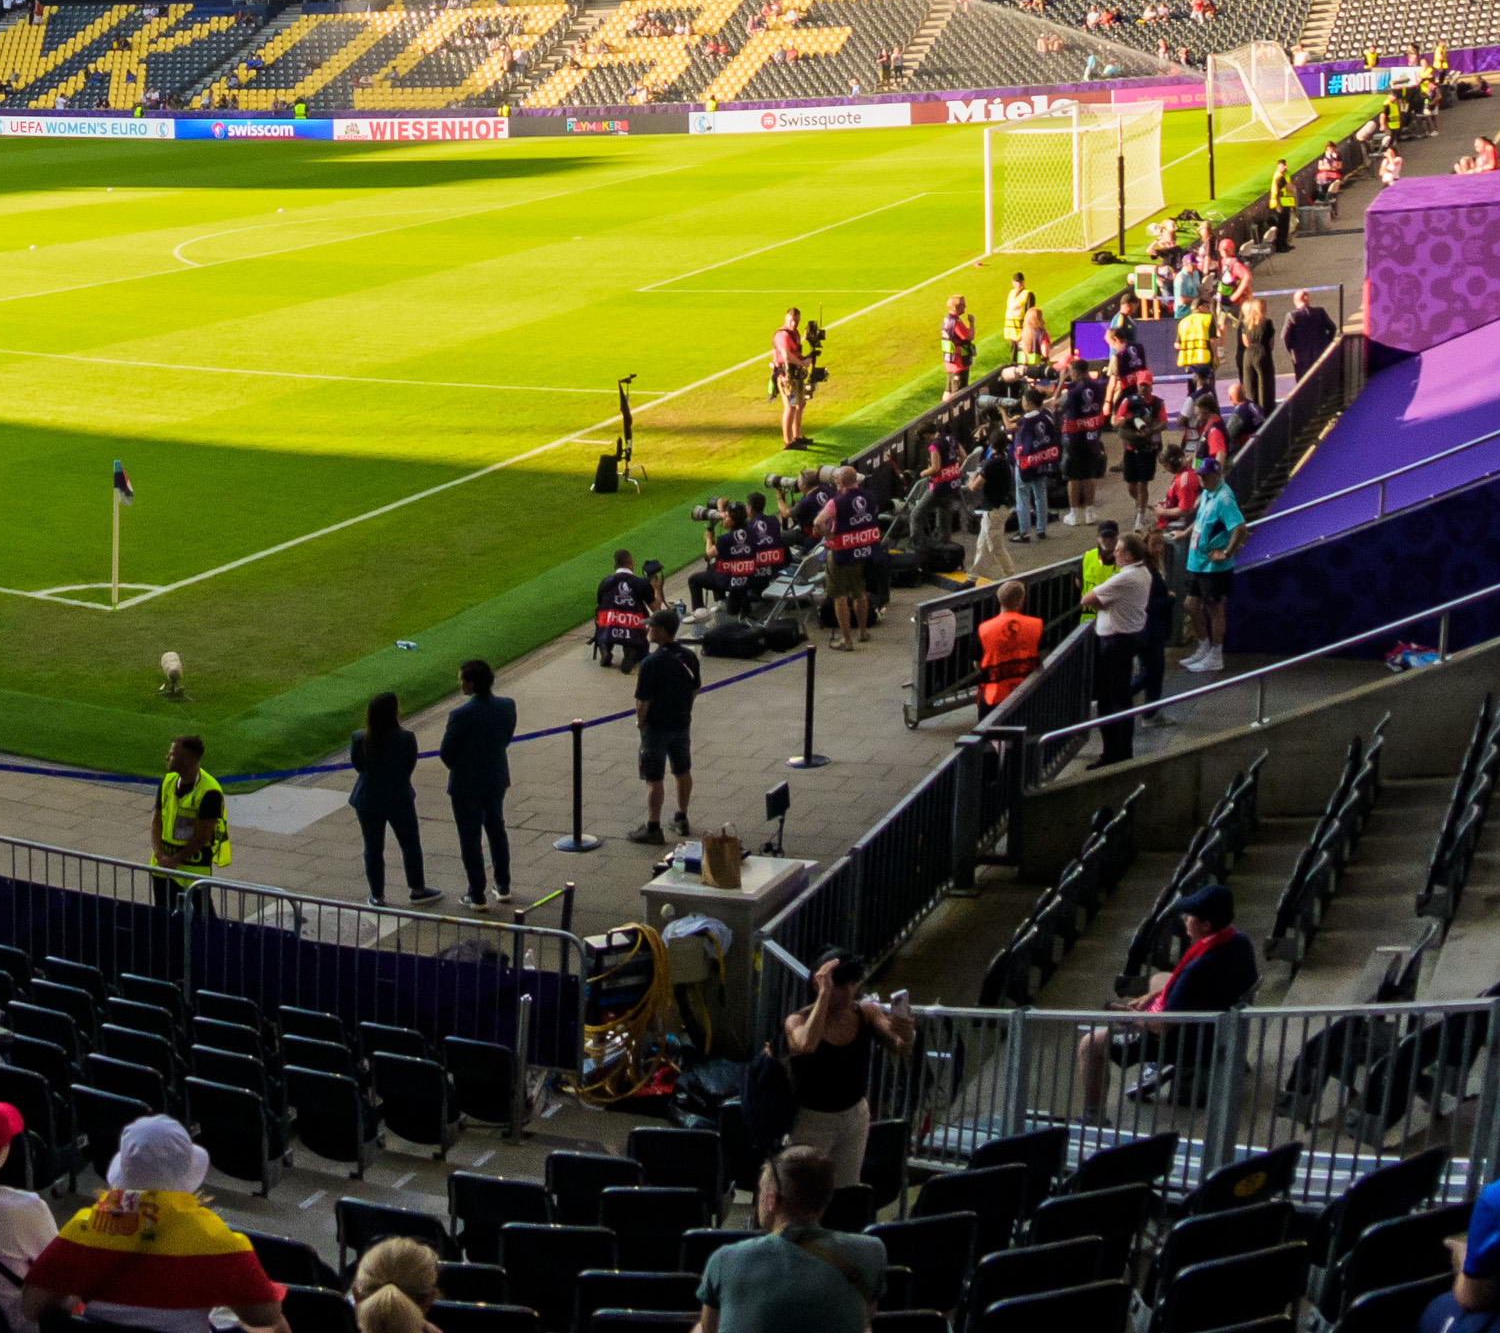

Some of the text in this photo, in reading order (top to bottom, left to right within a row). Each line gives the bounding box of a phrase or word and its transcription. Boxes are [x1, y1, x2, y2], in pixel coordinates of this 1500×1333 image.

[946, 95, 1079, 124] Miele
[10, 121, 148, 135] UEFA WOMEN'S EURO
[227, 121, 294, 137] swisscom
[779, 111, 863, 130] Swissquote
[369, 119, 506, 141] WIESENHOF
[1027, 446, 1060, 464] PHOTO
[842, 527, 880, 546] PHOTO
[722, 560, 755, 572] PHOTO
[607, 611, 641, 626] PHOTO
[612, 628, 631, 639] 021
